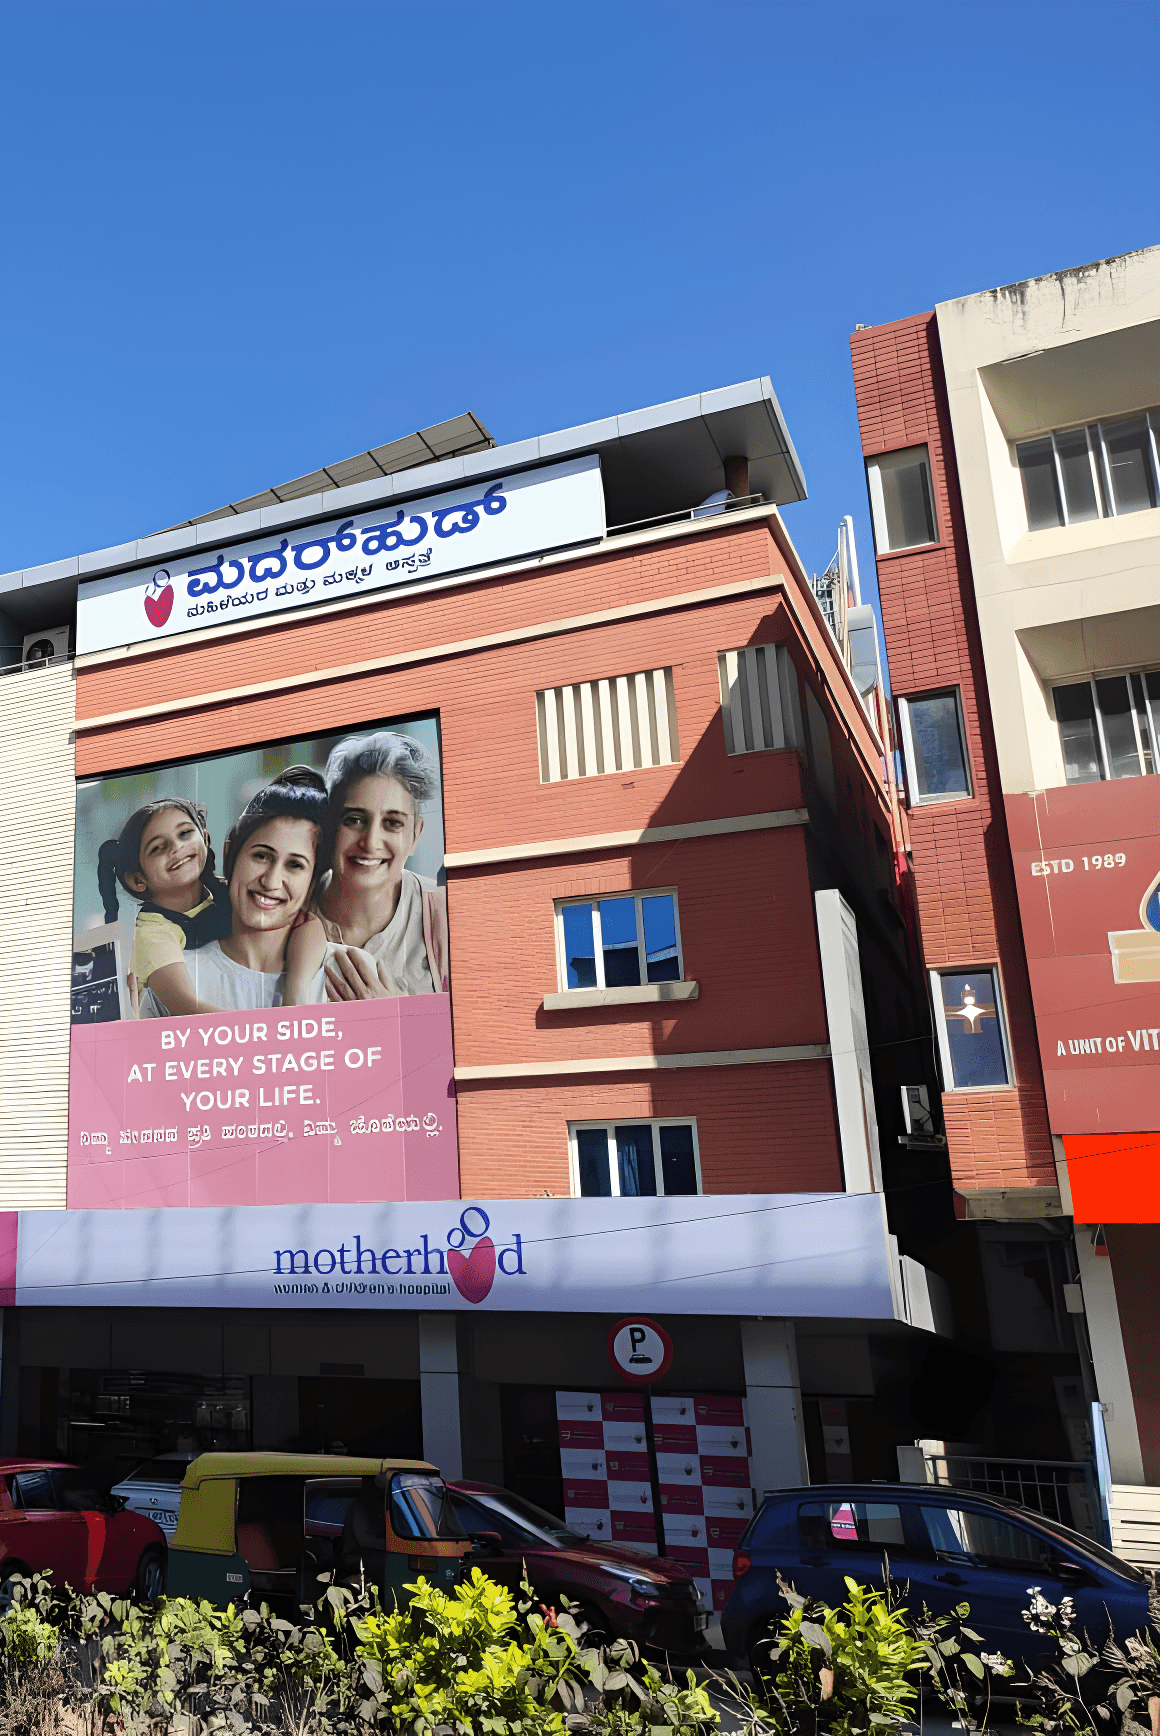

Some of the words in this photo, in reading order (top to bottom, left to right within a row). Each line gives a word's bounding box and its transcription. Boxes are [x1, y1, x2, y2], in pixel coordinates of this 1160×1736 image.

[1031, 858, 1074, 877] ESTD
[1081, 852, 1127, 871] 1989
[161, 1027, 191, 1050] BY
[198, 1022, 268, 1047] YOUR
[276, 1017, 343, 1041] SIDE,
[1056, 1039, 1067, 1057] A
[1068, 1037, 1103, 1055] UNIT
[1105, 1035, 1126, 1053] OF
[127, 1063, 157, 1084] AT
[165, 1056, 244, 1081] EVERY
[252, 1050, 335, 1075] STAGE
[344, 1046, 382, 1069] OF
[180, 1088, 250, 1112] YOUR
[258, 1084, 321, 1107] LIFE.
[629, 1326, 646, 1354] P
